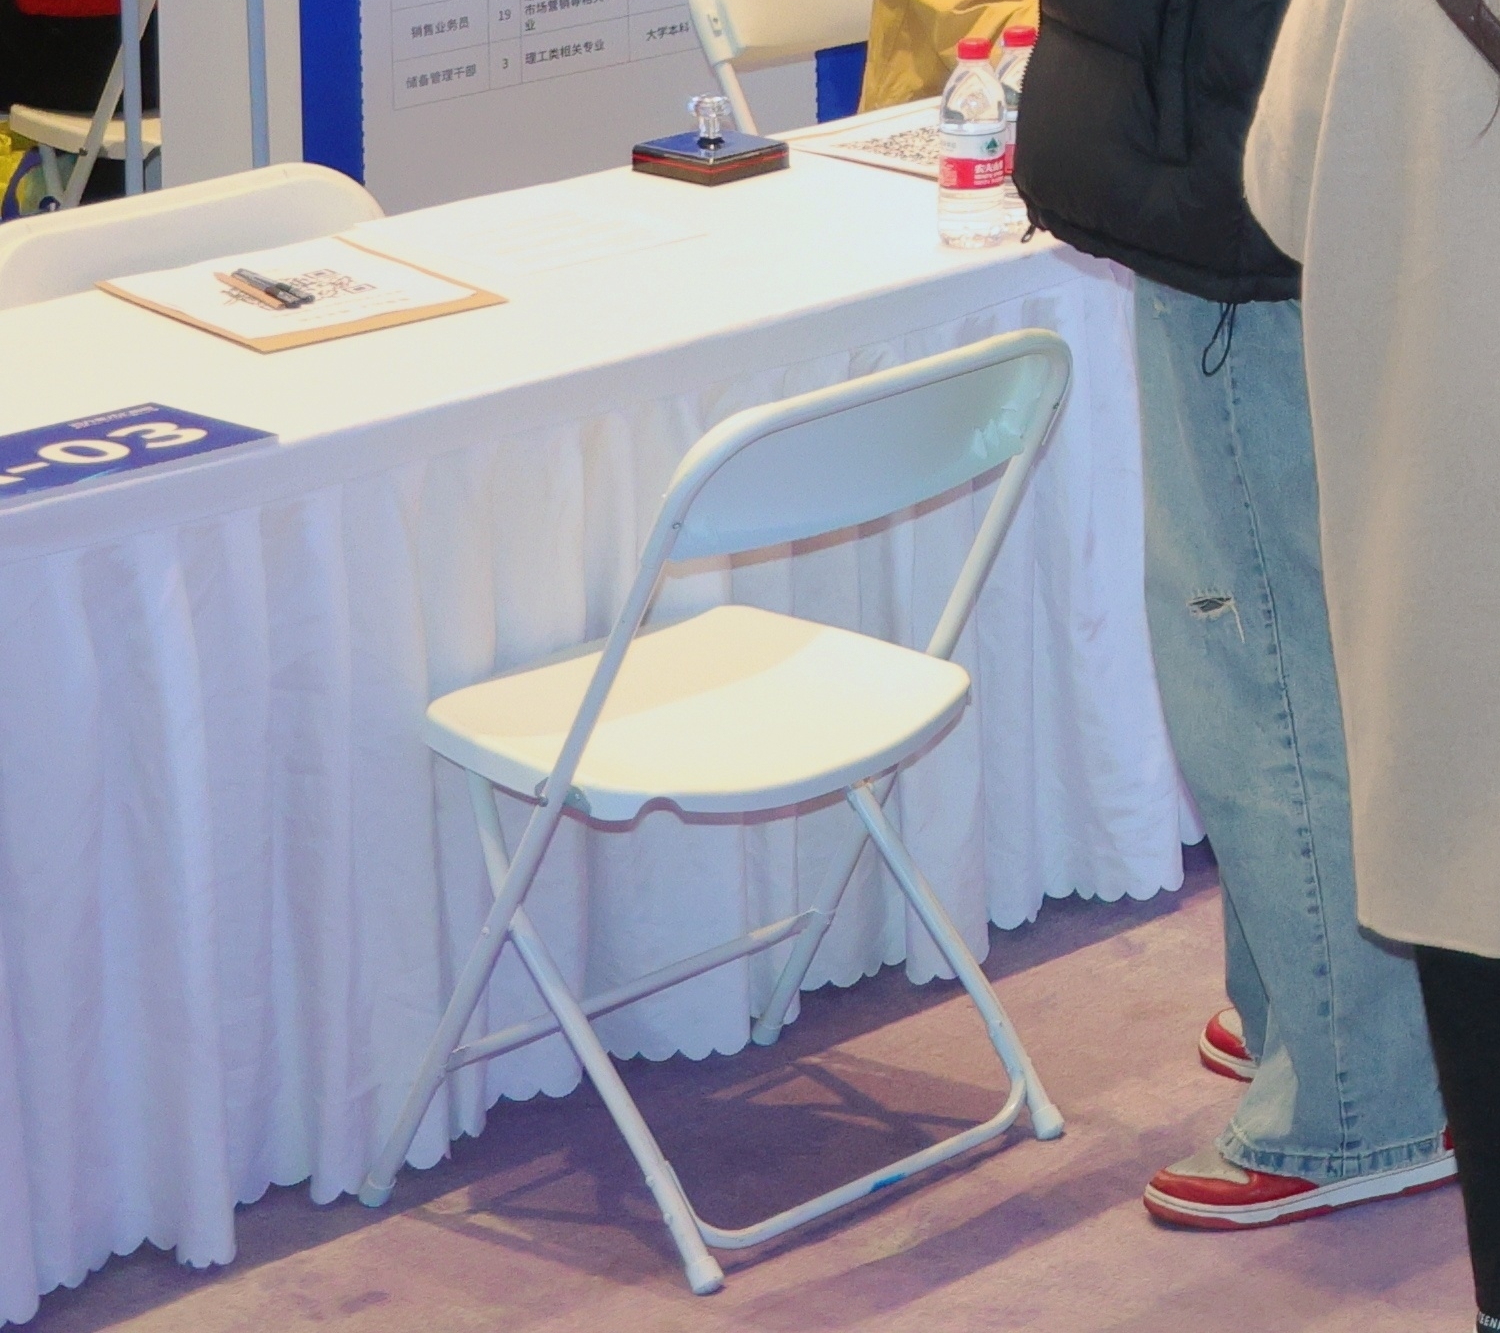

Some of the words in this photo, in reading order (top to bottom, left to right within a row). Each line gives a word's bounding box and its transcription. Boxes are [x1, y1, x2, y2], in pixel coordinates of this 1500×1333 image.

[498, 9, 511, 21] 19
[502, 58, 509, 69] 3
[0, 421, 208, 483] -03
